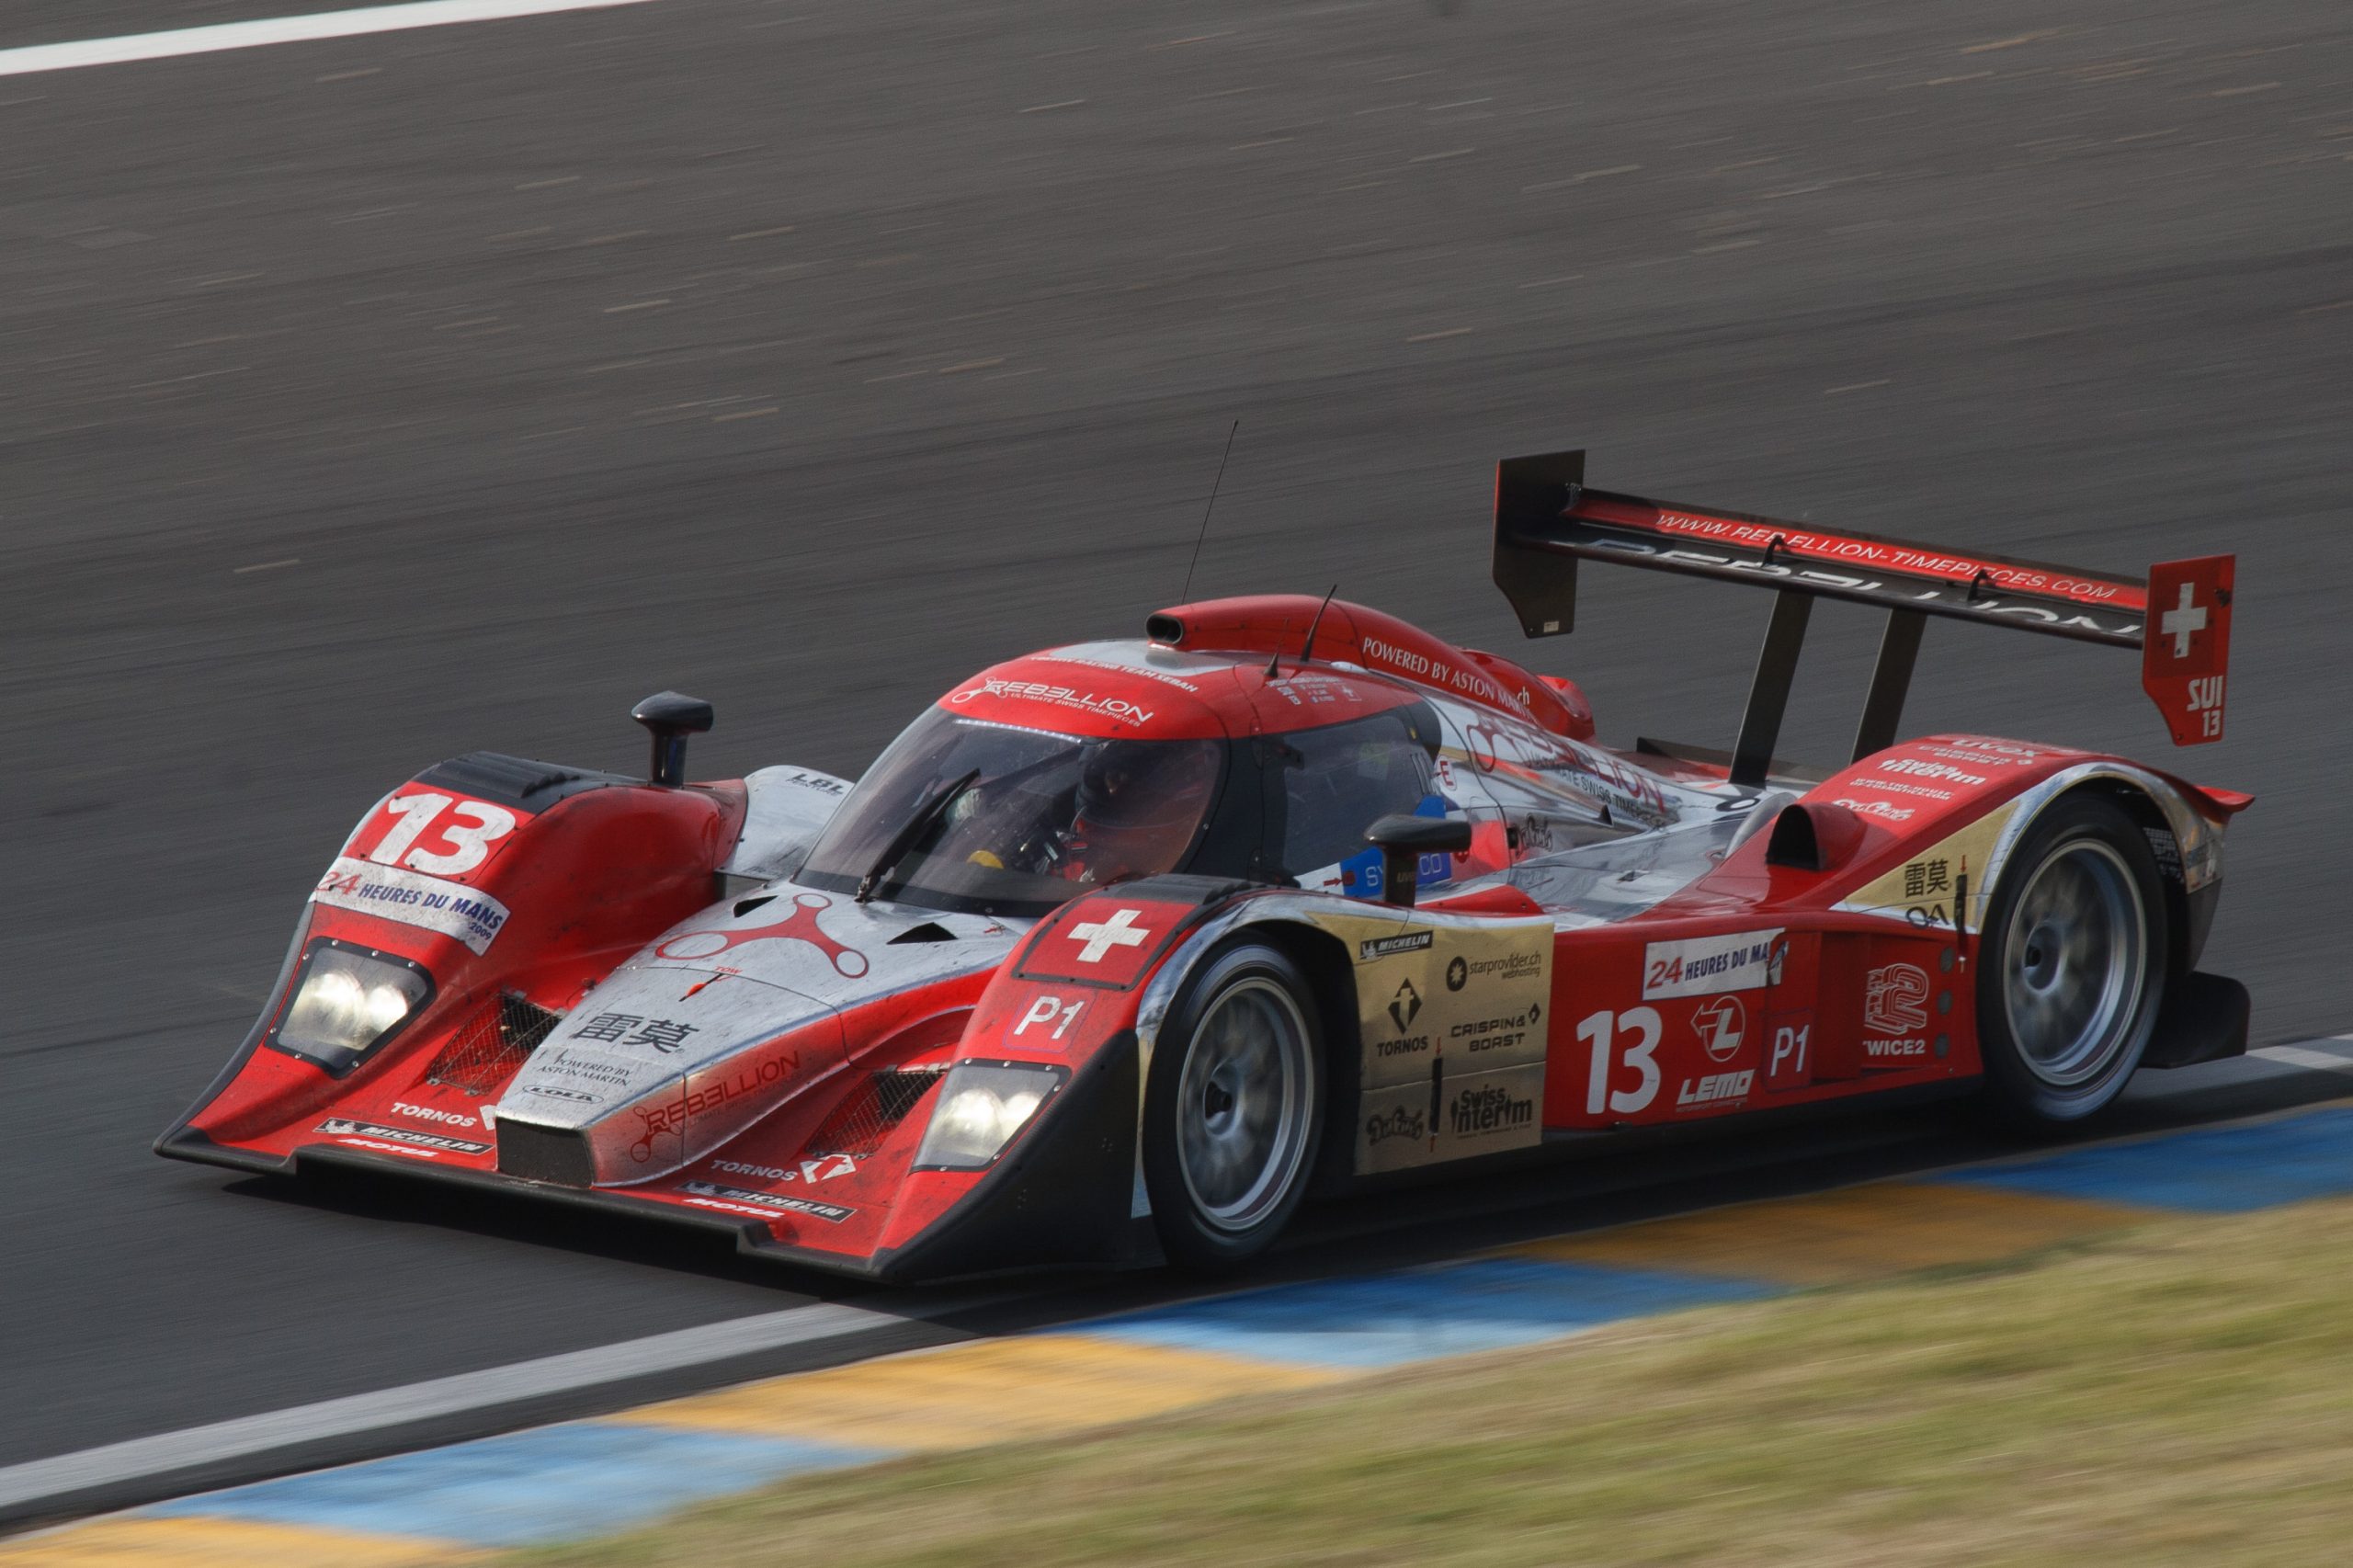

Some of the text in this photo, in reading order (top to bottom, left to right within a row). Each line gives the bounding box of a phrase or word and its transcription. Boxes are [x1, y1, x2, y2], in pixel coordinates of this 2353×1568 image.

[1362, 636, 1428, 675] POWERED
[1432, 663, 1450, 681] BY
[1452, 670, 1495, 700] ASTON
[2188, 676, 2224, 710] SUI
[2202, 710, 2221, 737] 13
[369, 793, 516, 875] 13
[317, 870, 503, 929] 24 HEURES DU MANS
[469, 922, 492, 941] 2009
[1378, 935, 1430, 952] MICHELIN
[1646, 956, 1683, 990] 24
[1685, 952, 1729, 981] HEURES
[1731, 948, 1748, 970] DU
[1013, 995, 1085, 1040] P1
[1450, 1017, 1515, 1039] CRISPIN
[571, 1012, 700, 1054] 雷莫
[1377, 1035, 1429, 1058] TORNOS
[1469, 1032, 1526, 1052] BORST
[1576, 1006, 1663, 1114] 13
[1769, 1024, 1810, 1077] P1
[537, 1065, 632, 1087] ASTON MARTIN
[553, 1057, 615, 1073] POWERED
[529, 1087, 594, 1102] LOLA
[646, 1051, 800, 1134] REBELLION
[1676, 1068, 1756, 1106] LEMO
[391, 1102, 477, 1127] TORNOS
[359, 1126, 484, 1152] MICHELIN
[710, 1159, 799, 1182] TORNOS
[722, 1189, 845, 1218] MICHELIN
